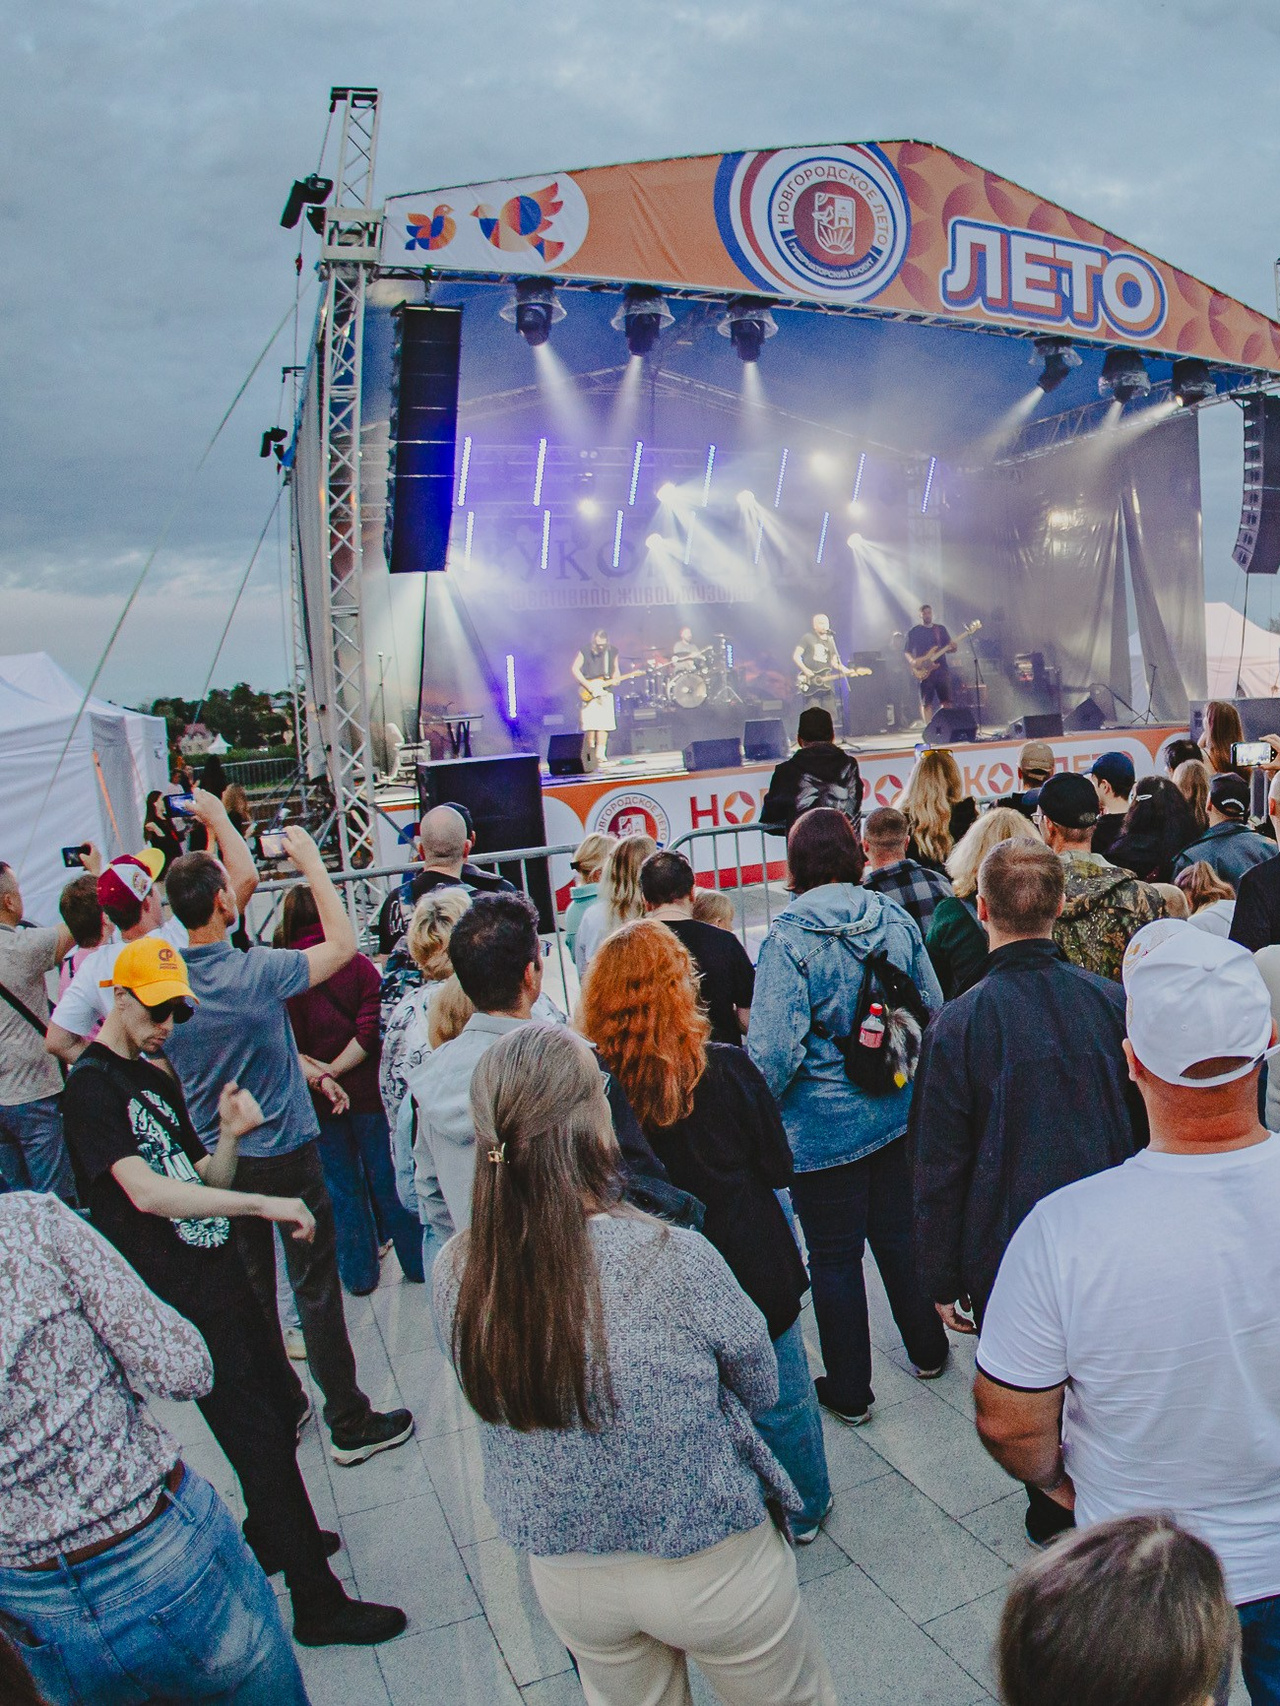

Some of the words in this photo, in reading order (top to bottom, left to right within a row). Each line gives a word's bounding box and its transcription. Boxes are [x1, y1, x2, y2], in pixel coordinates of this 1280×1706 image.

[778, 166, 877, 224] НОВГОРОДСКОЕ
[872, 203, 889, 245] ЛЕТО
[943, 220, 1162, 334] ЛЕТО
[655, 812, 668, 841] ЛЕТО
